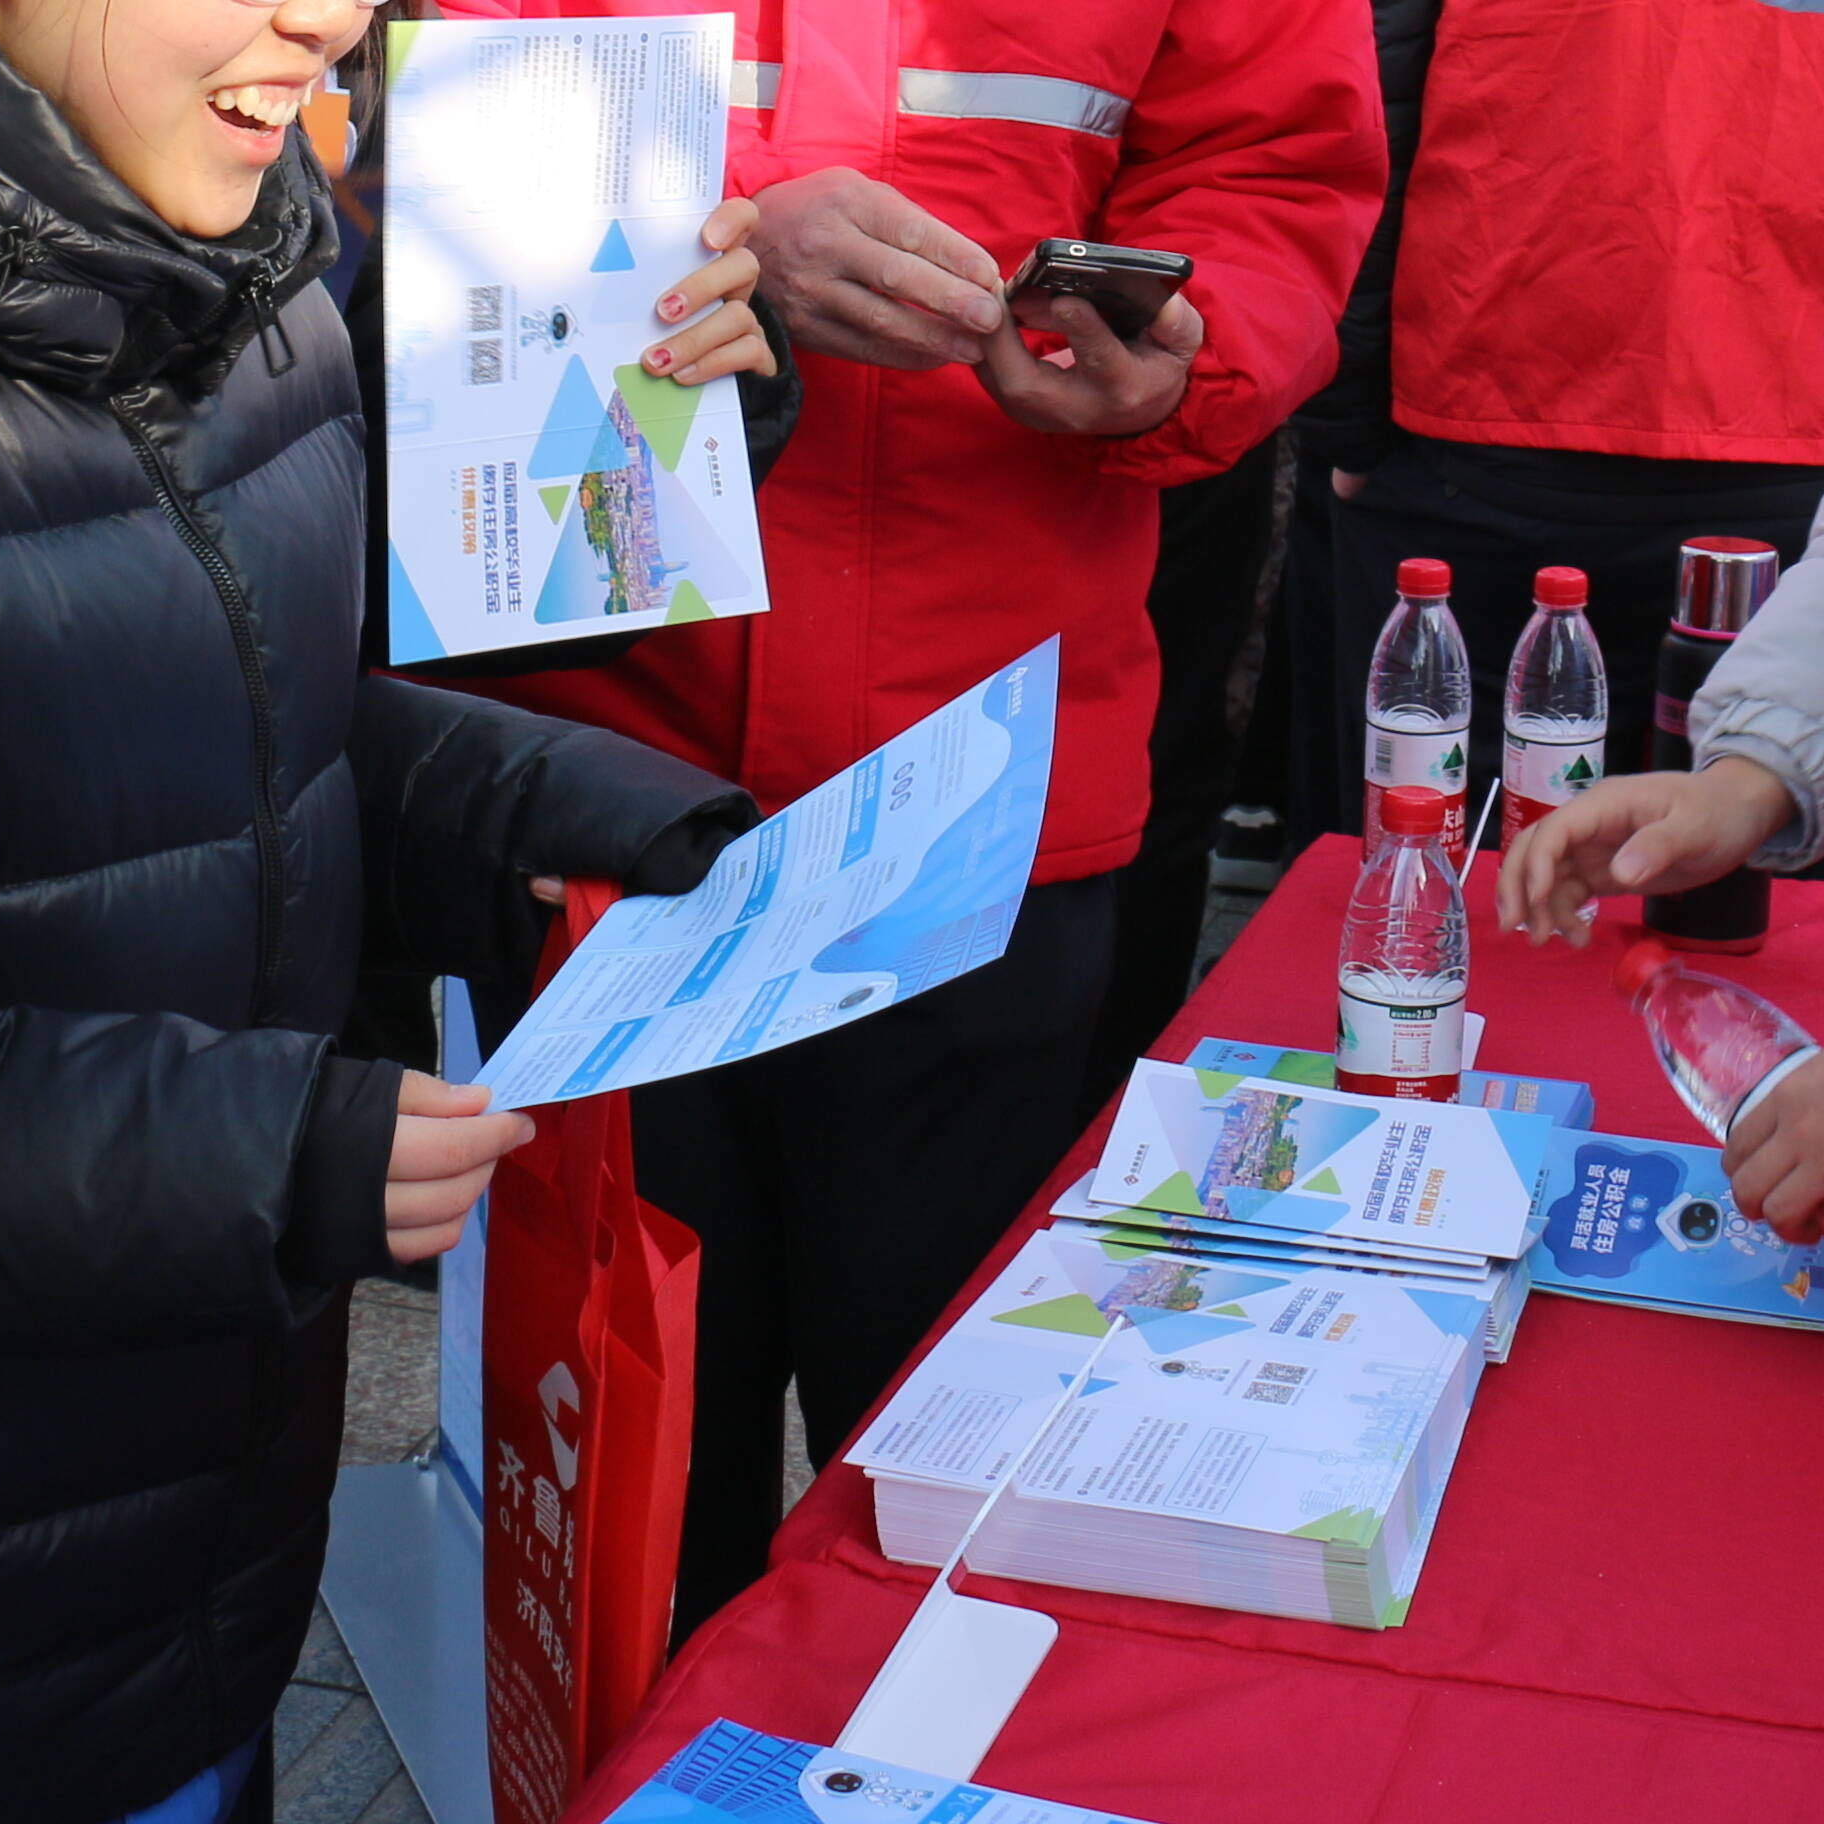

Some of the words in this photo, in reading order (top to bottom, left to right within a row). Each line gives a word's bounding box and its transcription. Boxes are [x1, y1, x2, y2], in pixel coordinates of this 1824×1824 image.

[502, 460, 522, 613] 应届高校毕业生
[1362, 1120, 1407, 1222] 应届高校毕业生
[1388, 1124, 1433, 1224] 缴存住房公积金
[1414, 1167, 1446, 1227] 优惠政策
[1570, 1163, 1608, 1251] 灵活就业人员
[1592, 1166, 1631, 1253] 住房公积金
